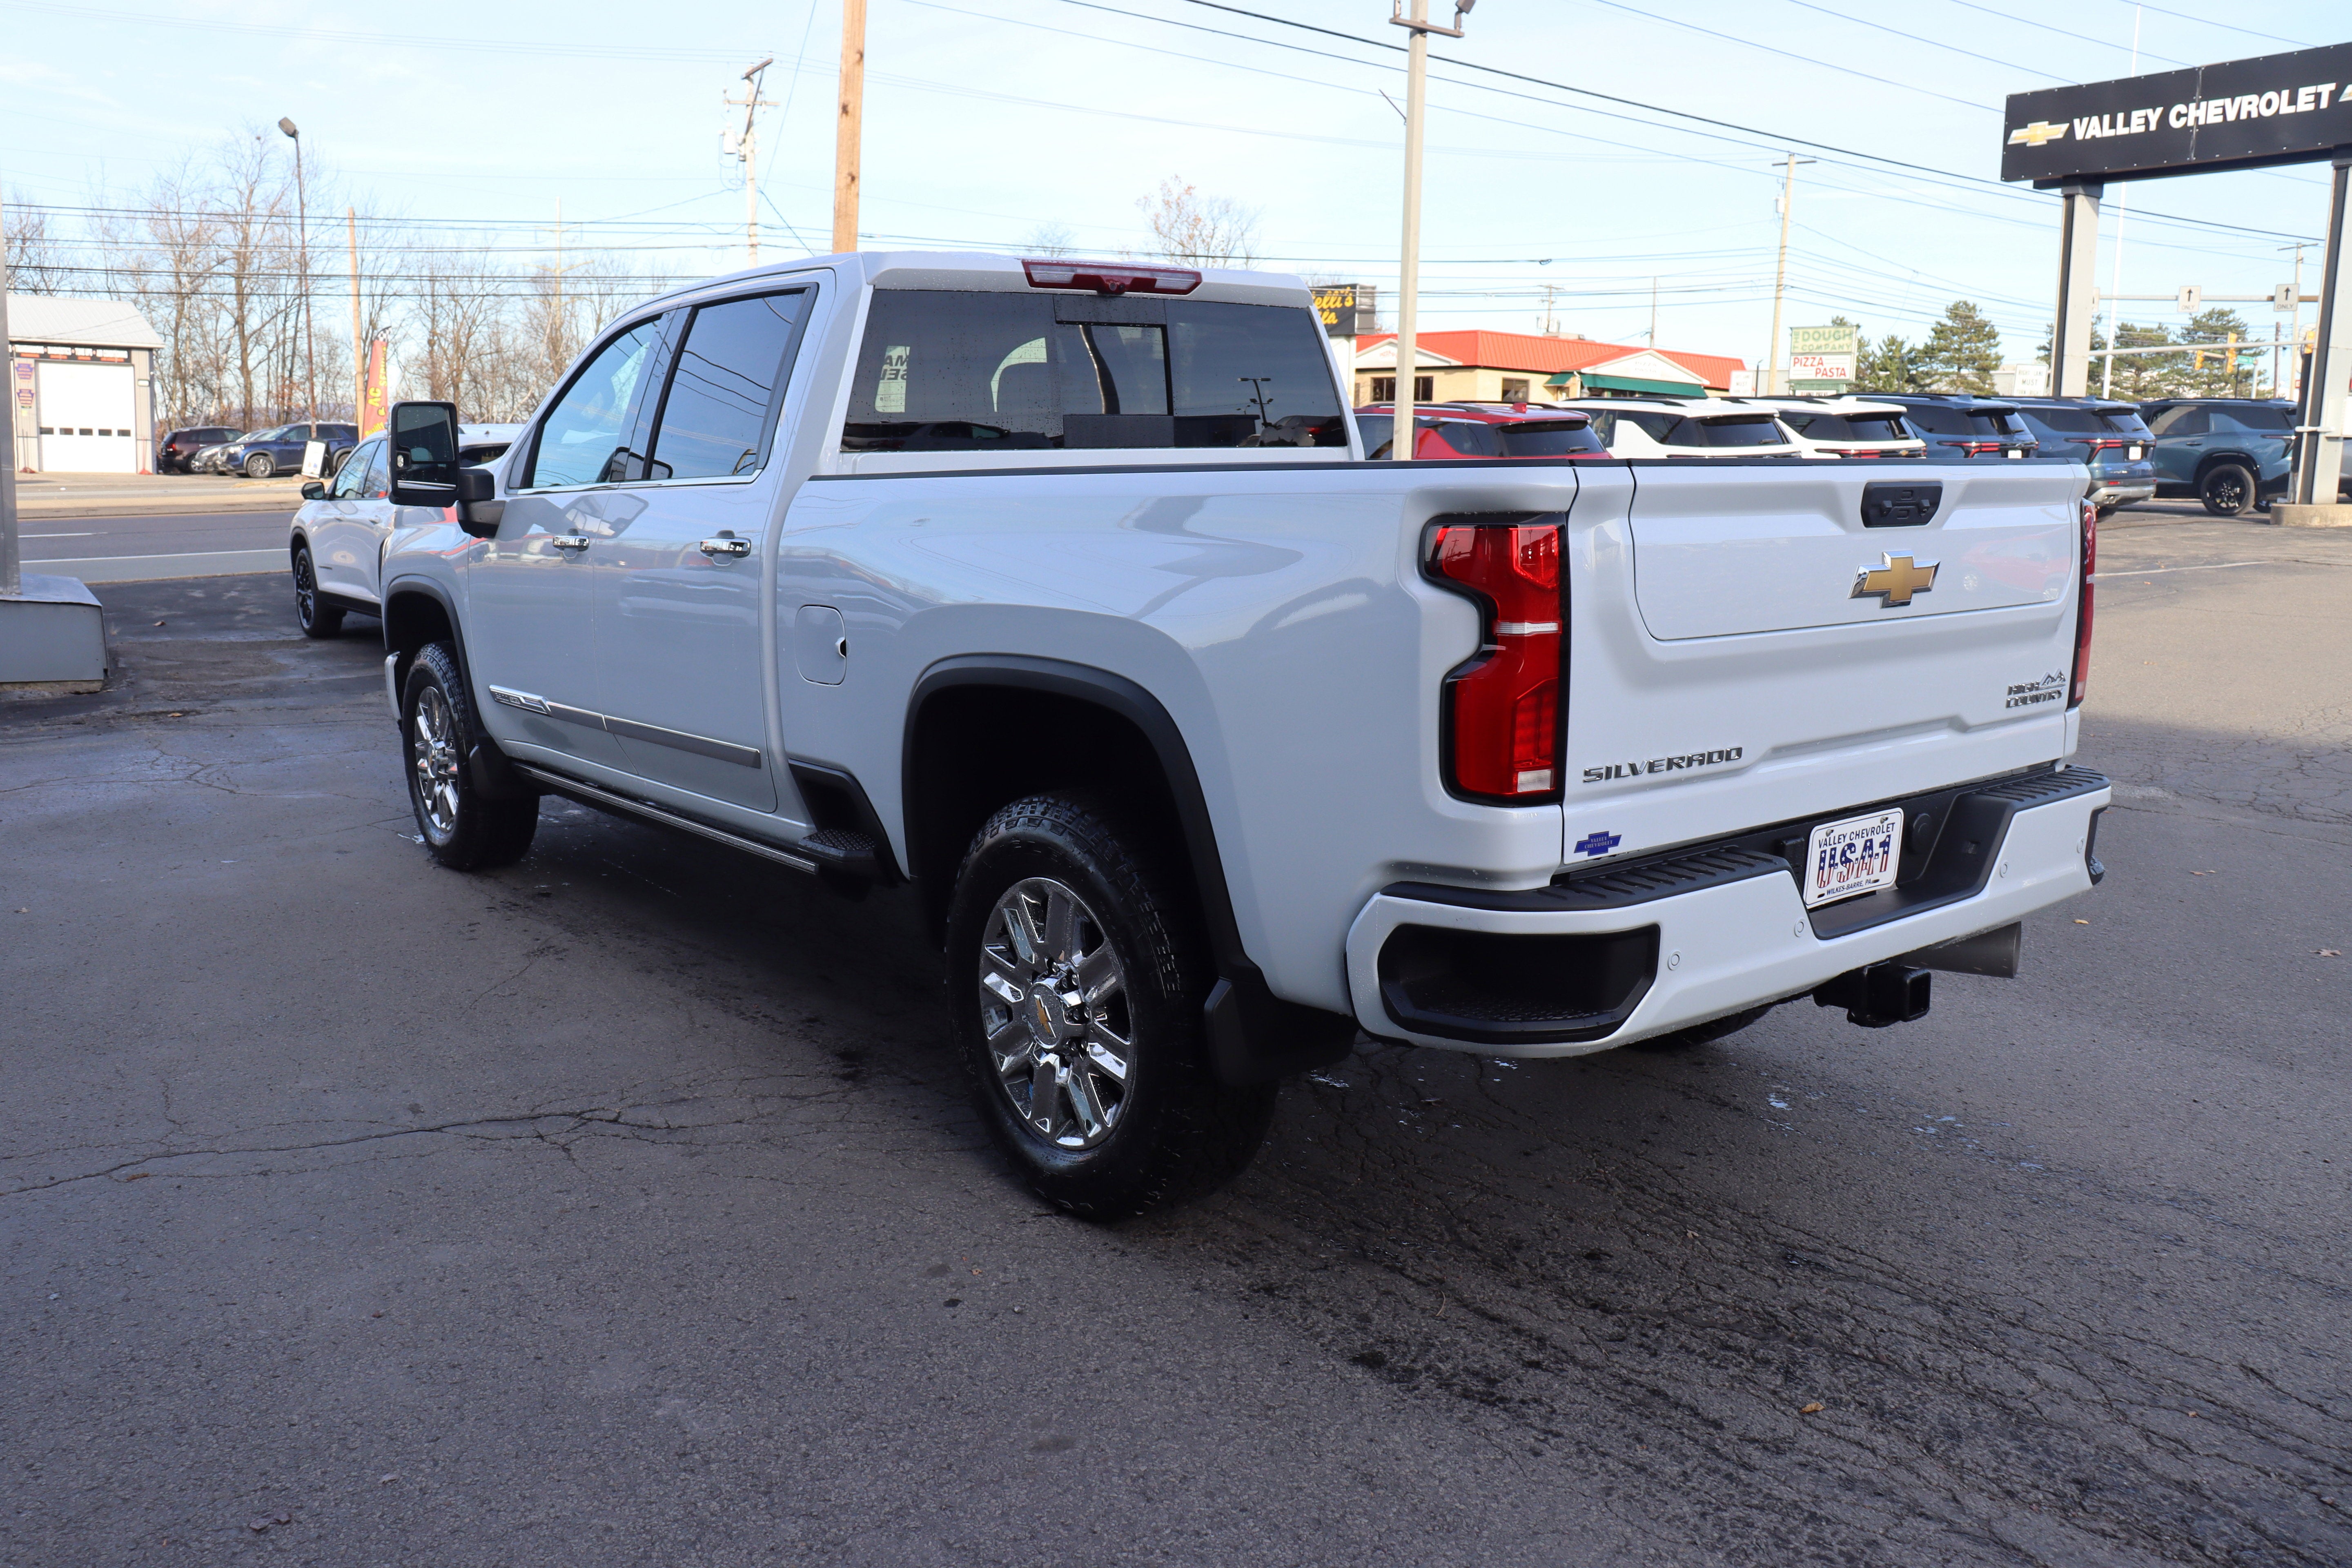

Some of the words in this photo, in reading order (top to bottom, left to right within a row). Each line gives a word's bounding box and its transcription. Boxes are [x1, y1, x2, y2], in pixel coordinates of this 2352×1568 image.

[2073, 107, 2164, 140] VALLEY
[2169, 83, 2336, 129] CHEVROLET
[1802, 330, 1853, 341] DOUGH
[1793, 356, 1824, 367] PIZZA
[1815, 368, 1846, 377] PASTA
[368, 387, 382, 407] AC
[1583, 746, 1743, 783] SILVERADO
[1818, 833, 1848, 849] VALLEY
[1849, 822, 1895, 841] CHEVROLET
[1584, 840, 1613, 849] CHEVROLET
[1826, 881, 1864, 895] WILKES-BARRE,
